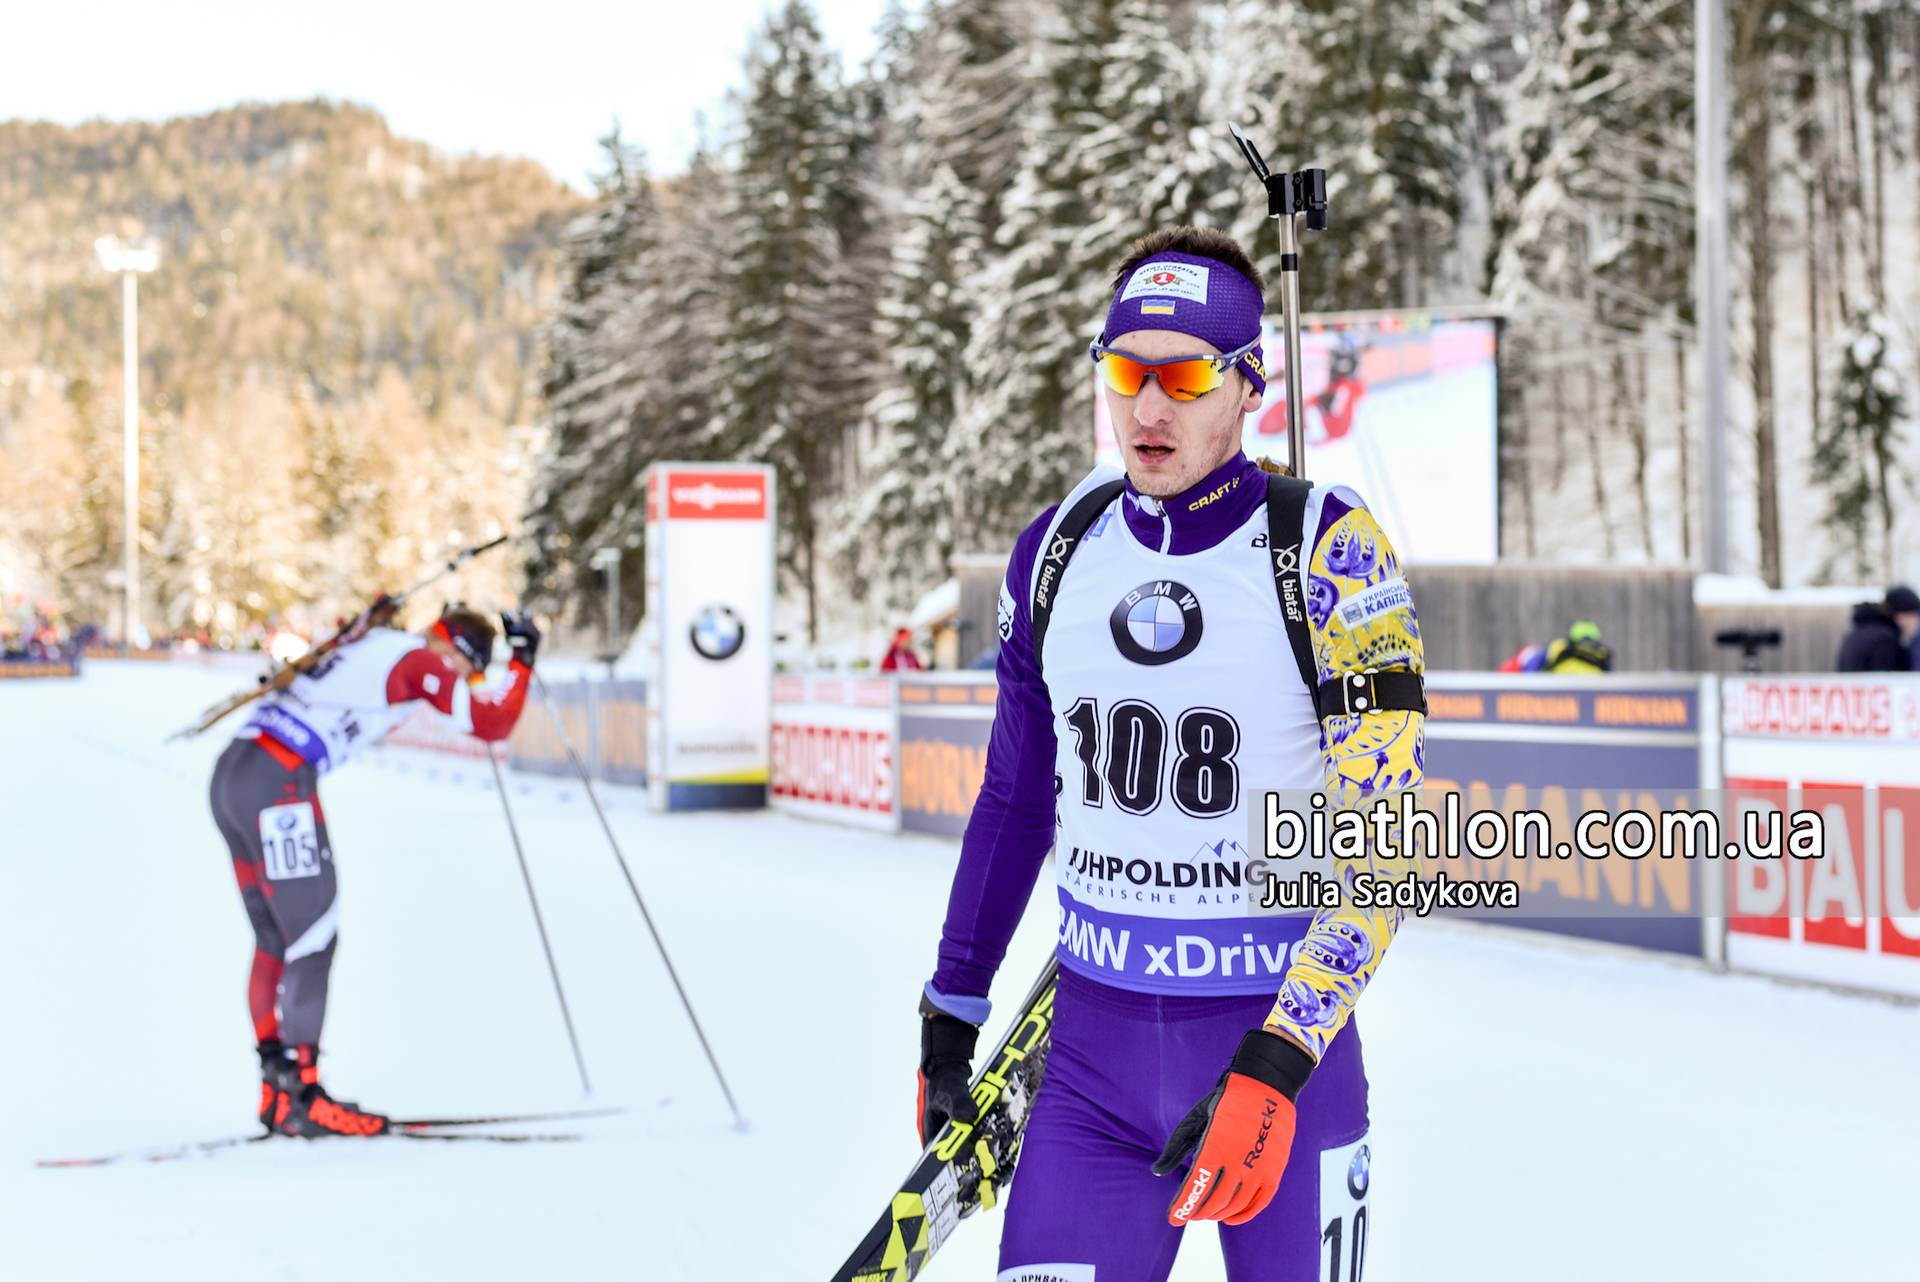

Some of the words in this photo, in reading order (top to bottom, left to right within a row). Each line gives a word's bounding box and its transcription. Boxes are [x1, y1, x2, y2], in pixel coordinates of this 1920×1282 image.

[1244, 351, 1266, 382] CRA
[1188, 482, 1232, 512] CRAFT
[1124, 581, 1198, 612] BMW
[1063, 697, 1241, 819] 108
